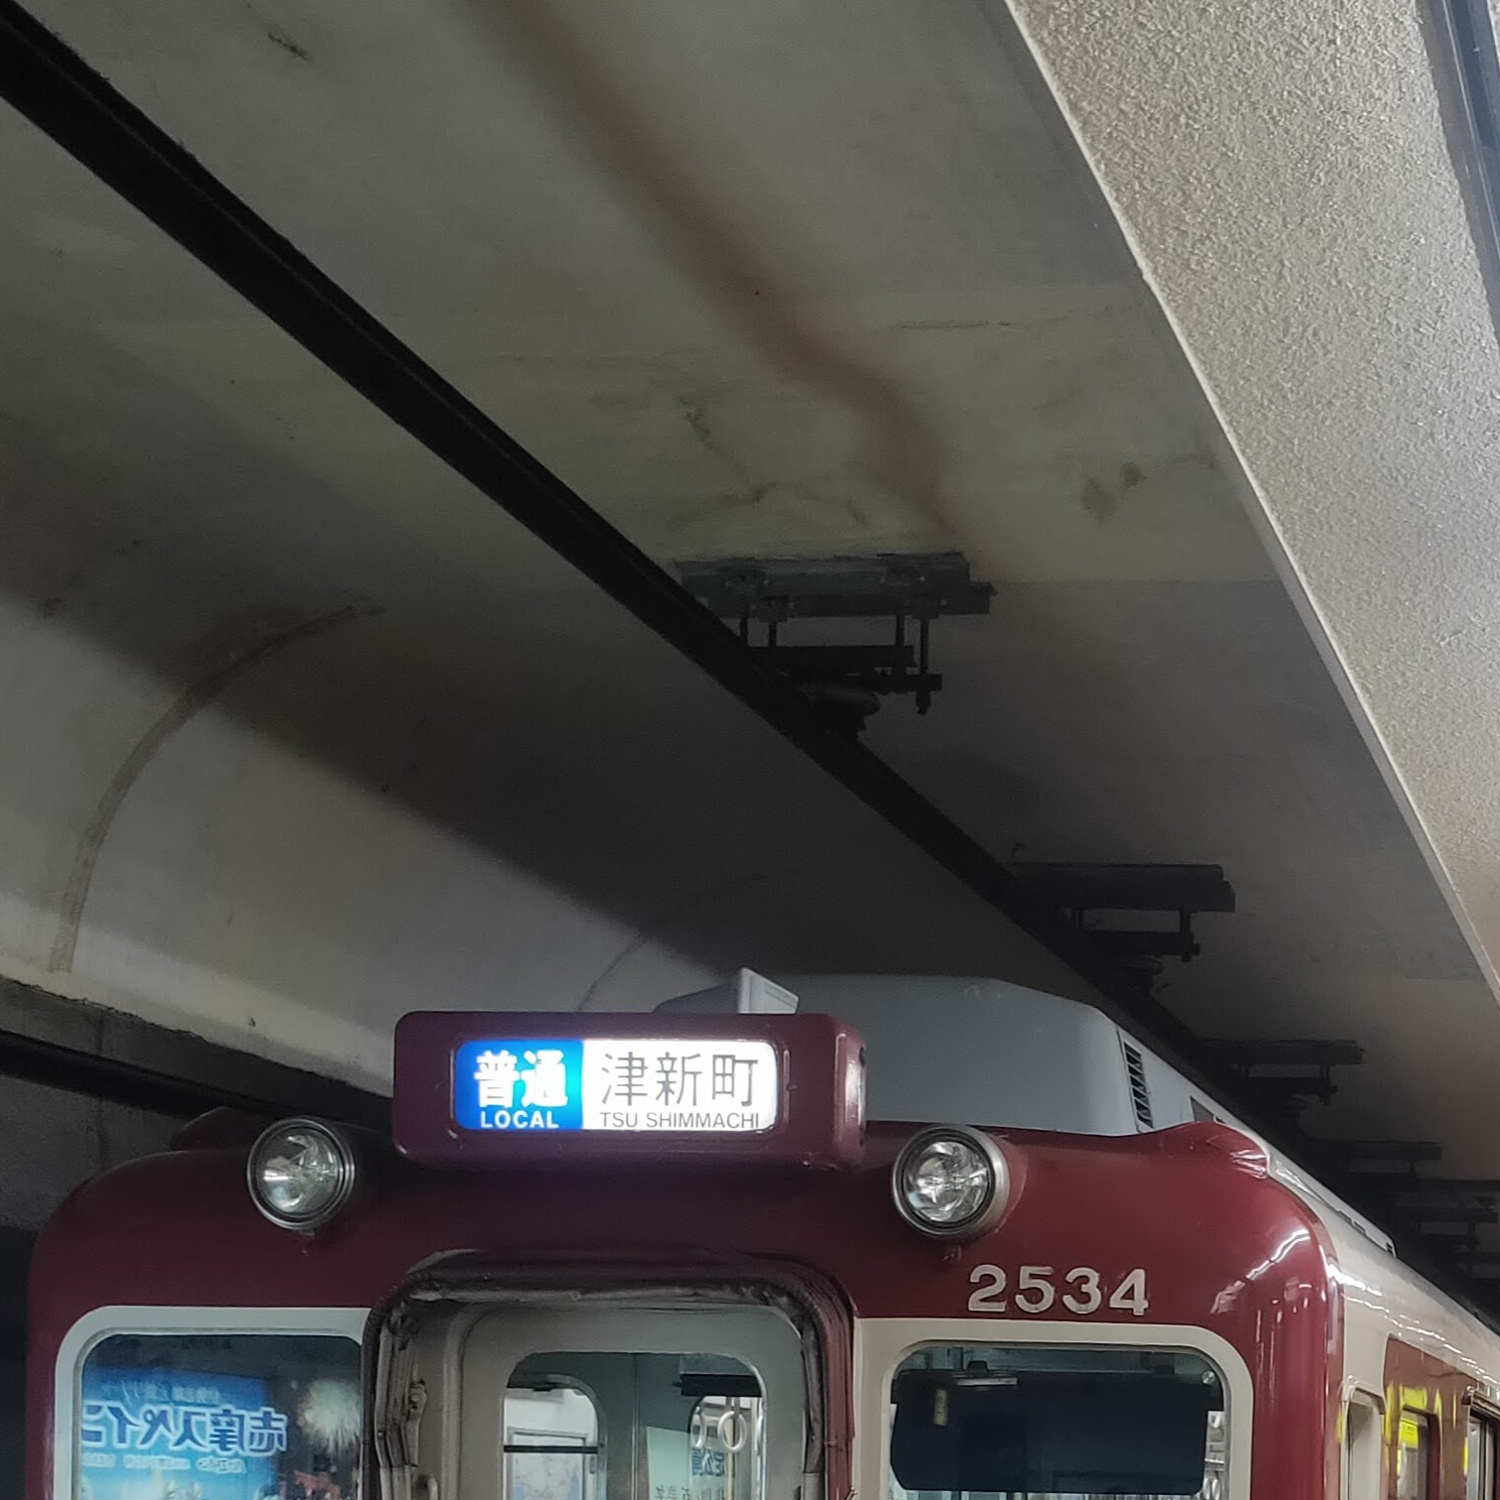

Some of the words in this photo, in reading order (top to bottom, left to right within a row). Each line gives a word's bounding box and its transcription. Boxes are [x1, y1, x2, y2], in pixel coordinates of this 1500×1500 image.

[474, 1050, 569, 1108] 普通
[601, 1051, 759, 1107] 津新町
[481, 1110, 559, 1129] LOCAL
[600, 1111, 638, 1129] TSU
[647, 1111, 760, 1130] SHIMMACHI
[967, 1264, 1149, 1316] 2534
